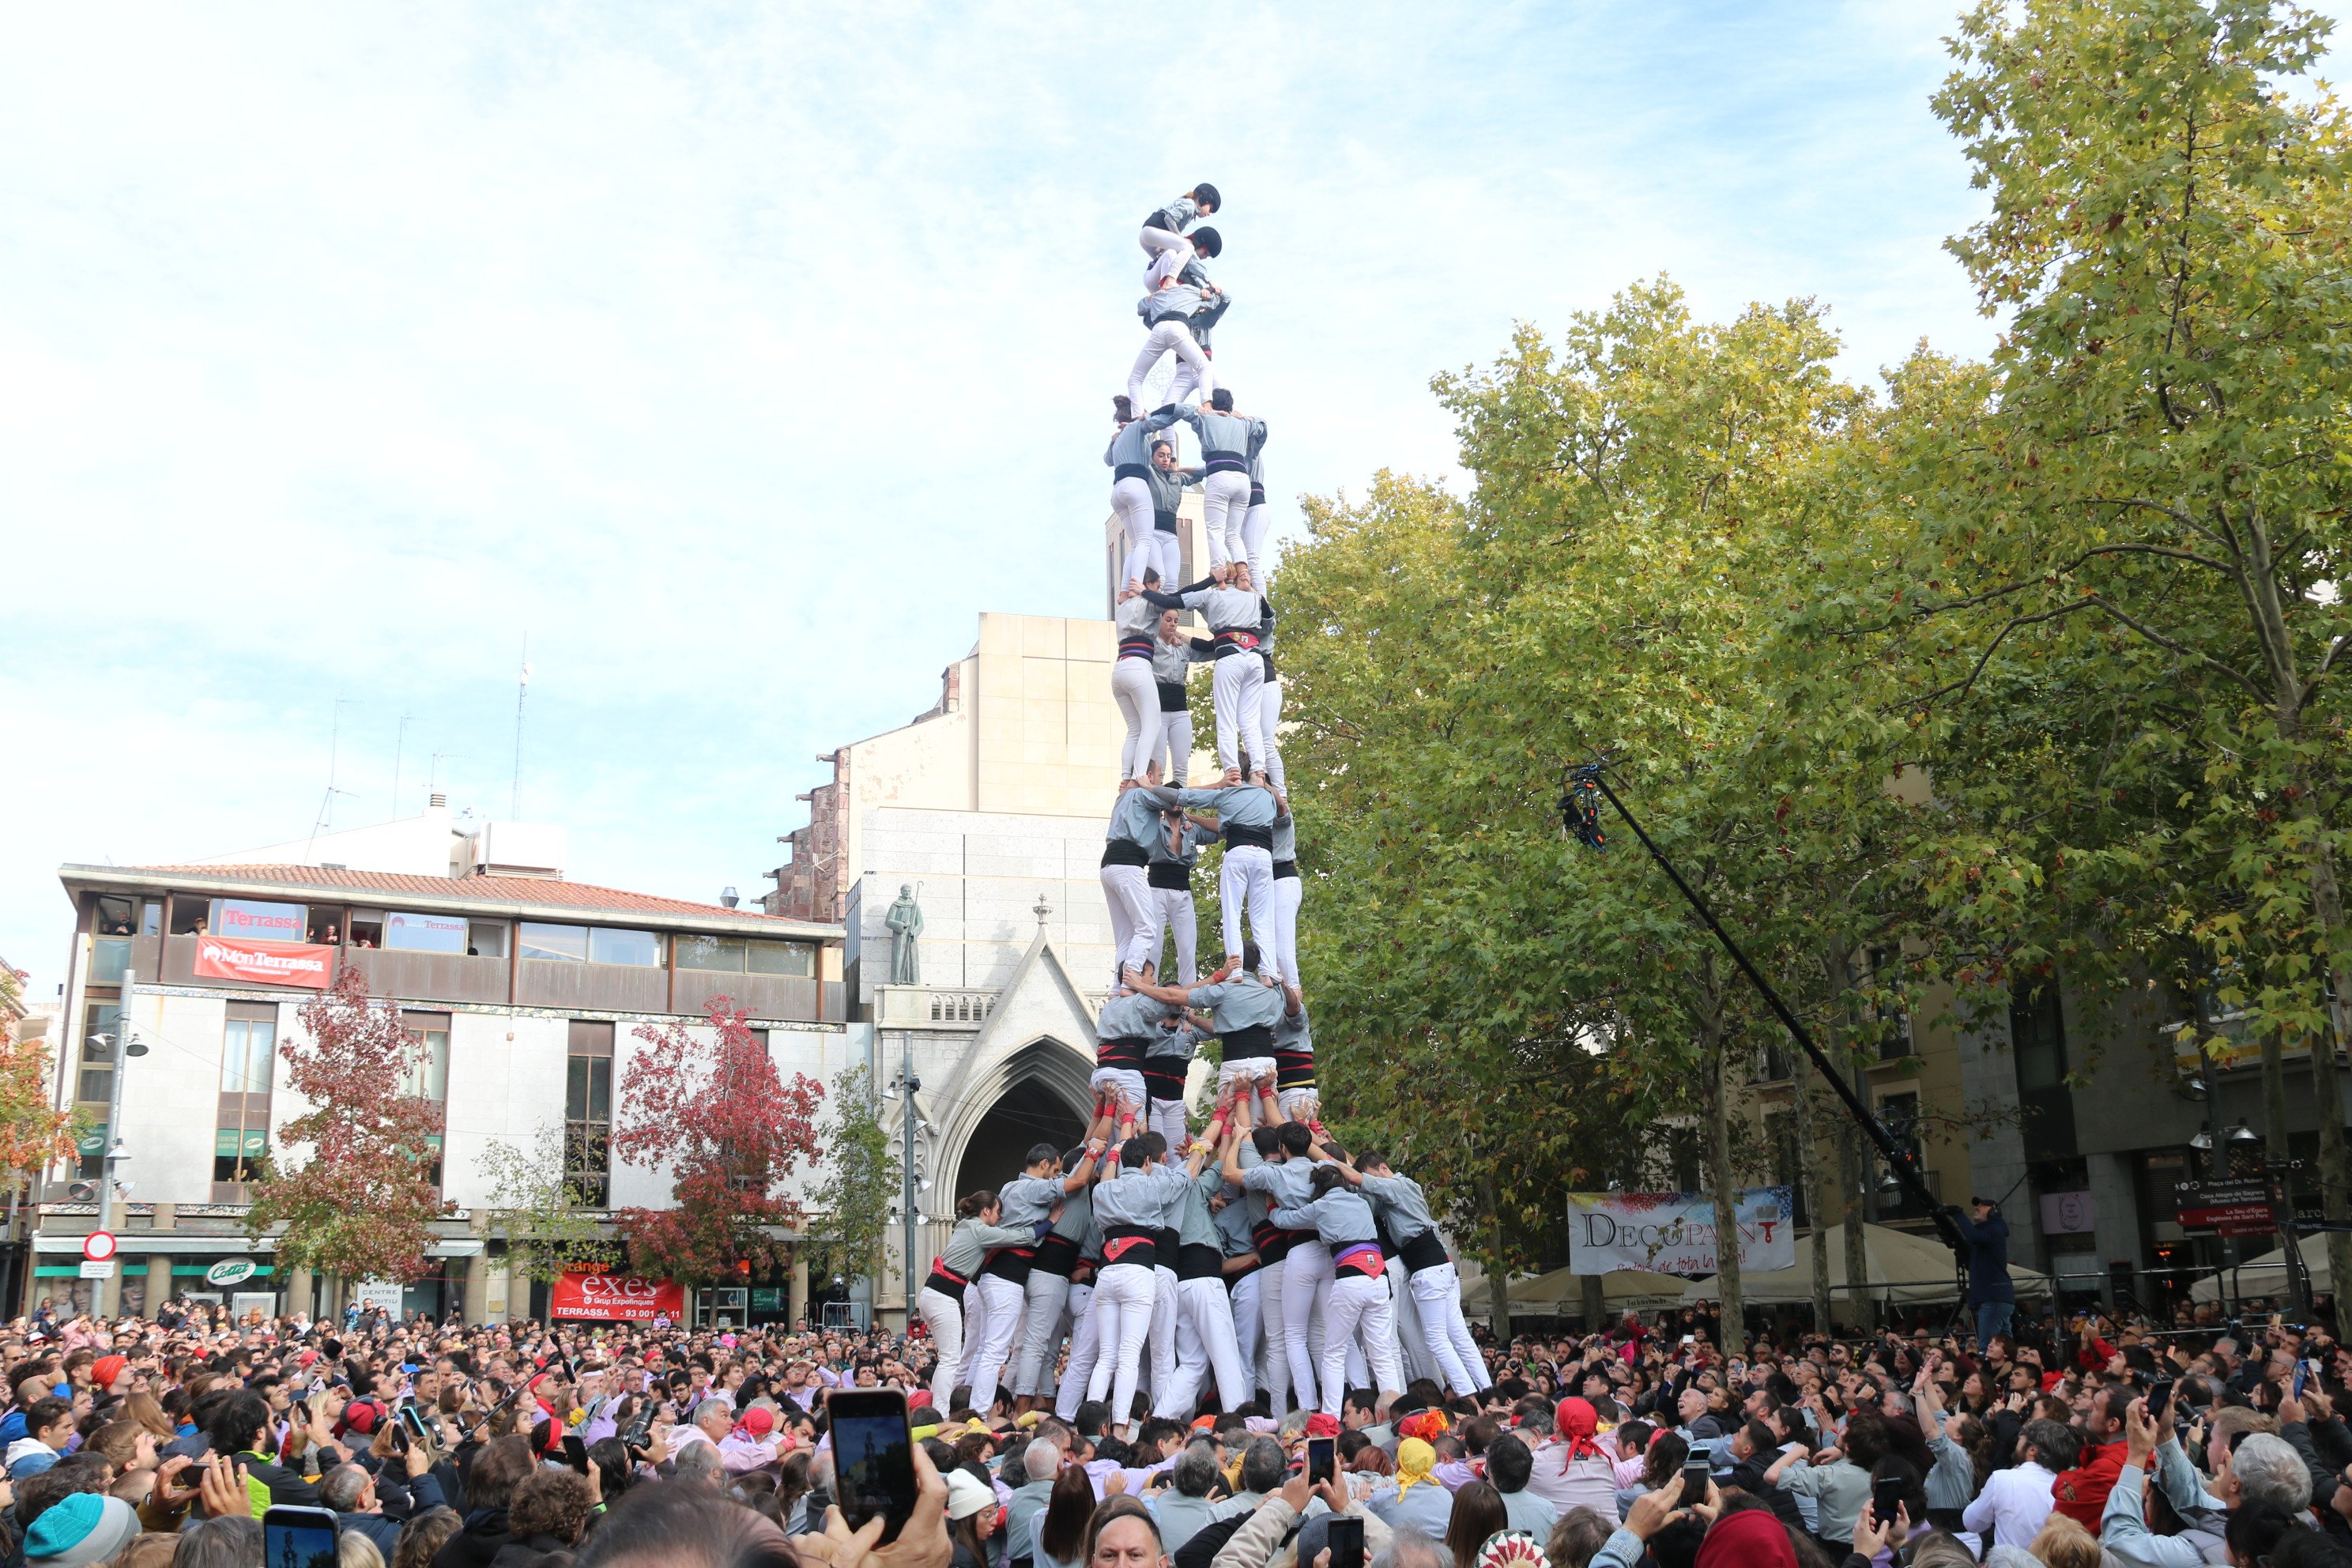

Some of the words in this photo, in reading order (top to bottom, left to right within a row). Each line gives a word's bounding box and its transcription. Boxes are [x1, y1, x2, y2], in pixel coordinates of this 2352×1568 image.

[226, 910, 303, 929] Terrassa
[424, 920, 465, 931] Terrassa
[210, 1262, 250, 1280] Cottet
[1658, 1260, 1672, 1272] de
[1676, 1255, 1699, 1273] tota
[1703, 1254, 1715, 1268] la
[581, 1276, 658, 1297] exes
[594, 1297, 611, 1306] Grup
[612, 1297, 654, 1306] Expofinques
[556, 1307, 610, 1317] TERRASSA
